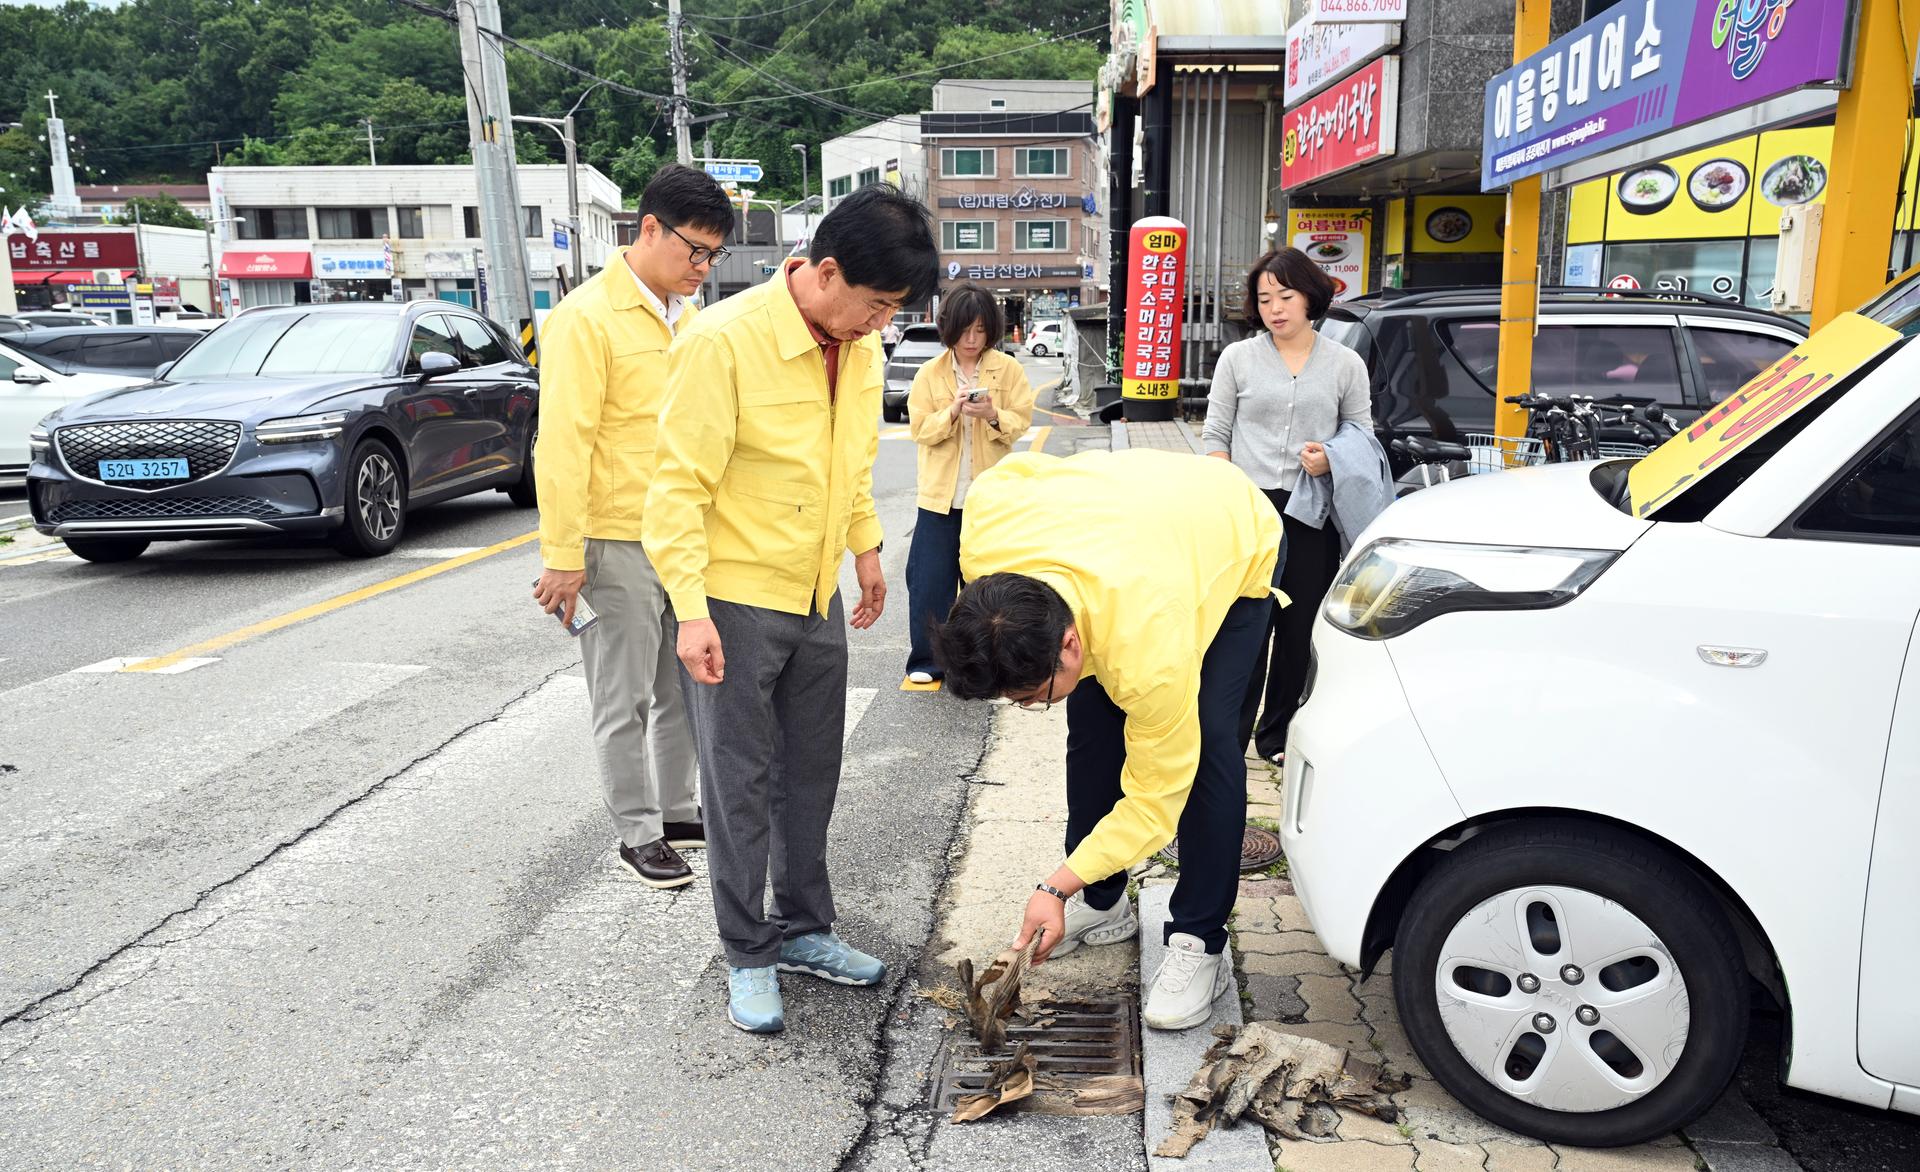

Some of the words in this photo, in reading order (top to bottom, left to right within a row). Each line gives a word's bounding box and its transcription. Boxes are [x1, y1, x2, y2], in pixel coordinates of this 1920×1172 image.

[1494, 0, 1661, 139] 어울링대여소
[1297, 73, 1376, 161] 한우소머리국밥
[1040, 193, 1067, 209] 전기
[1297, 220, 1363, 232] 여름별미
[1148, 235, 1177, 249] 엄마
[967, 263, 1042, 280] 금남전업사
[1334, 264, 1359, 273] 11,000
[1135, 255, 1160, 377] 한우소머리국밥
[1135, 383, 1170, 397] 소내장
[142, 461, 179, 477] 3257
